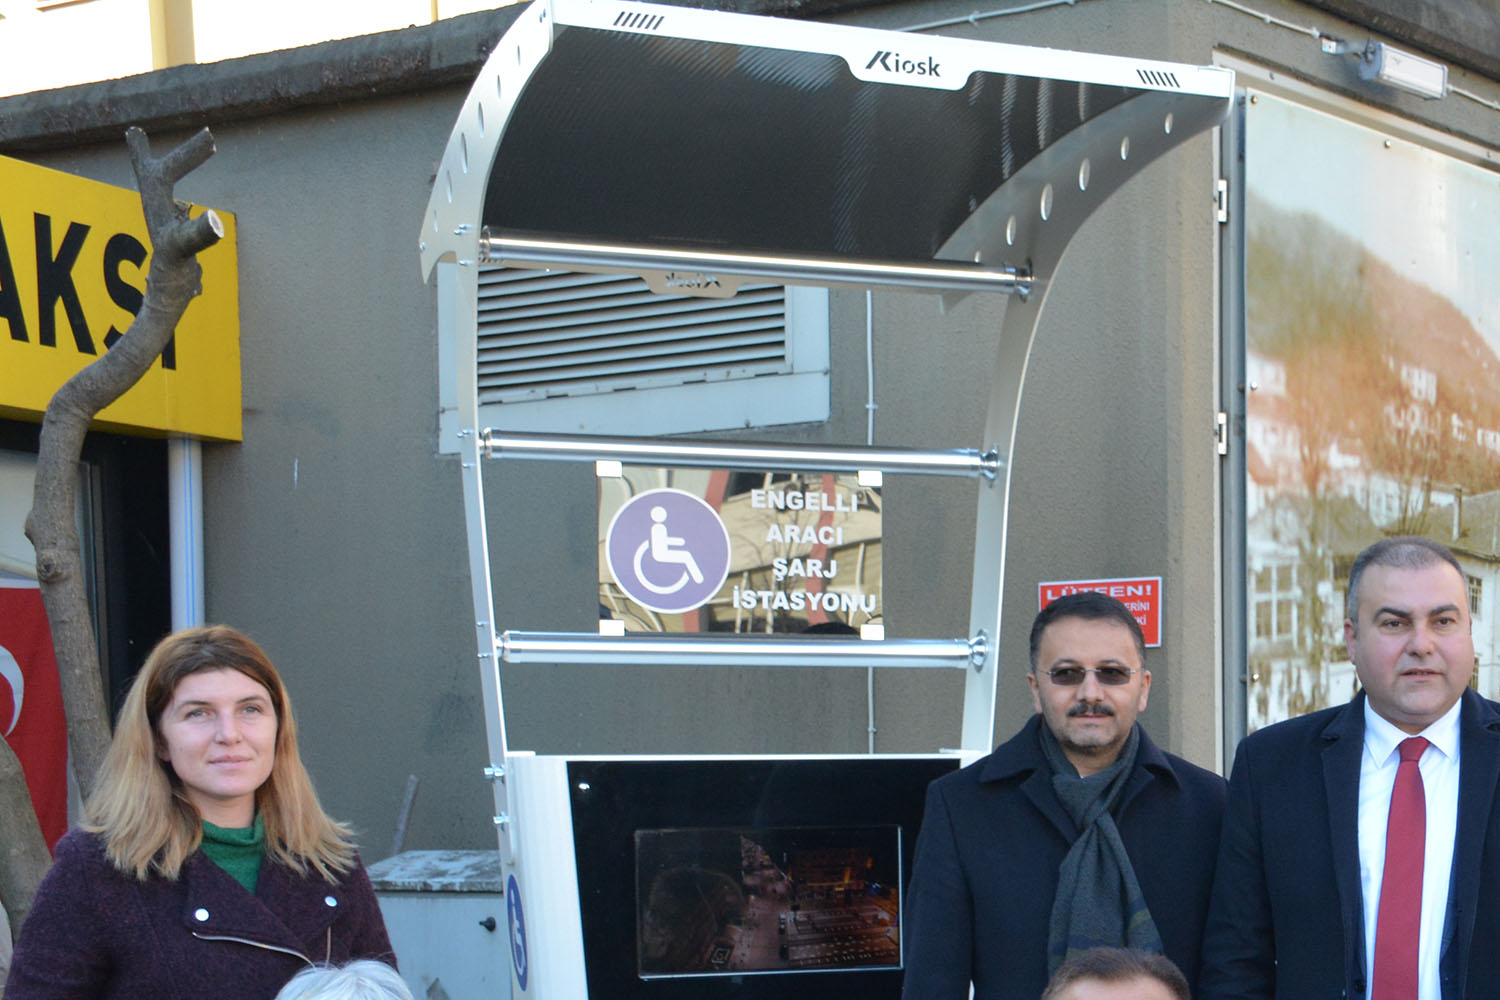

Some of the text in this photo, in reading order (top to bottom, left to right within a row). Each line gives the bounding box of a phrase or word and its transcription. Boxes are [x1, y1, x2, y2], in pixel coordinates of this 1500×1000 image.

[865, 51, 941, 77] Kiosk
[766, 524, 842, 545] ARACI
[773, 558, 838, 581] ŞARJ
[733, 585, 876, 613] İSTASYONU
